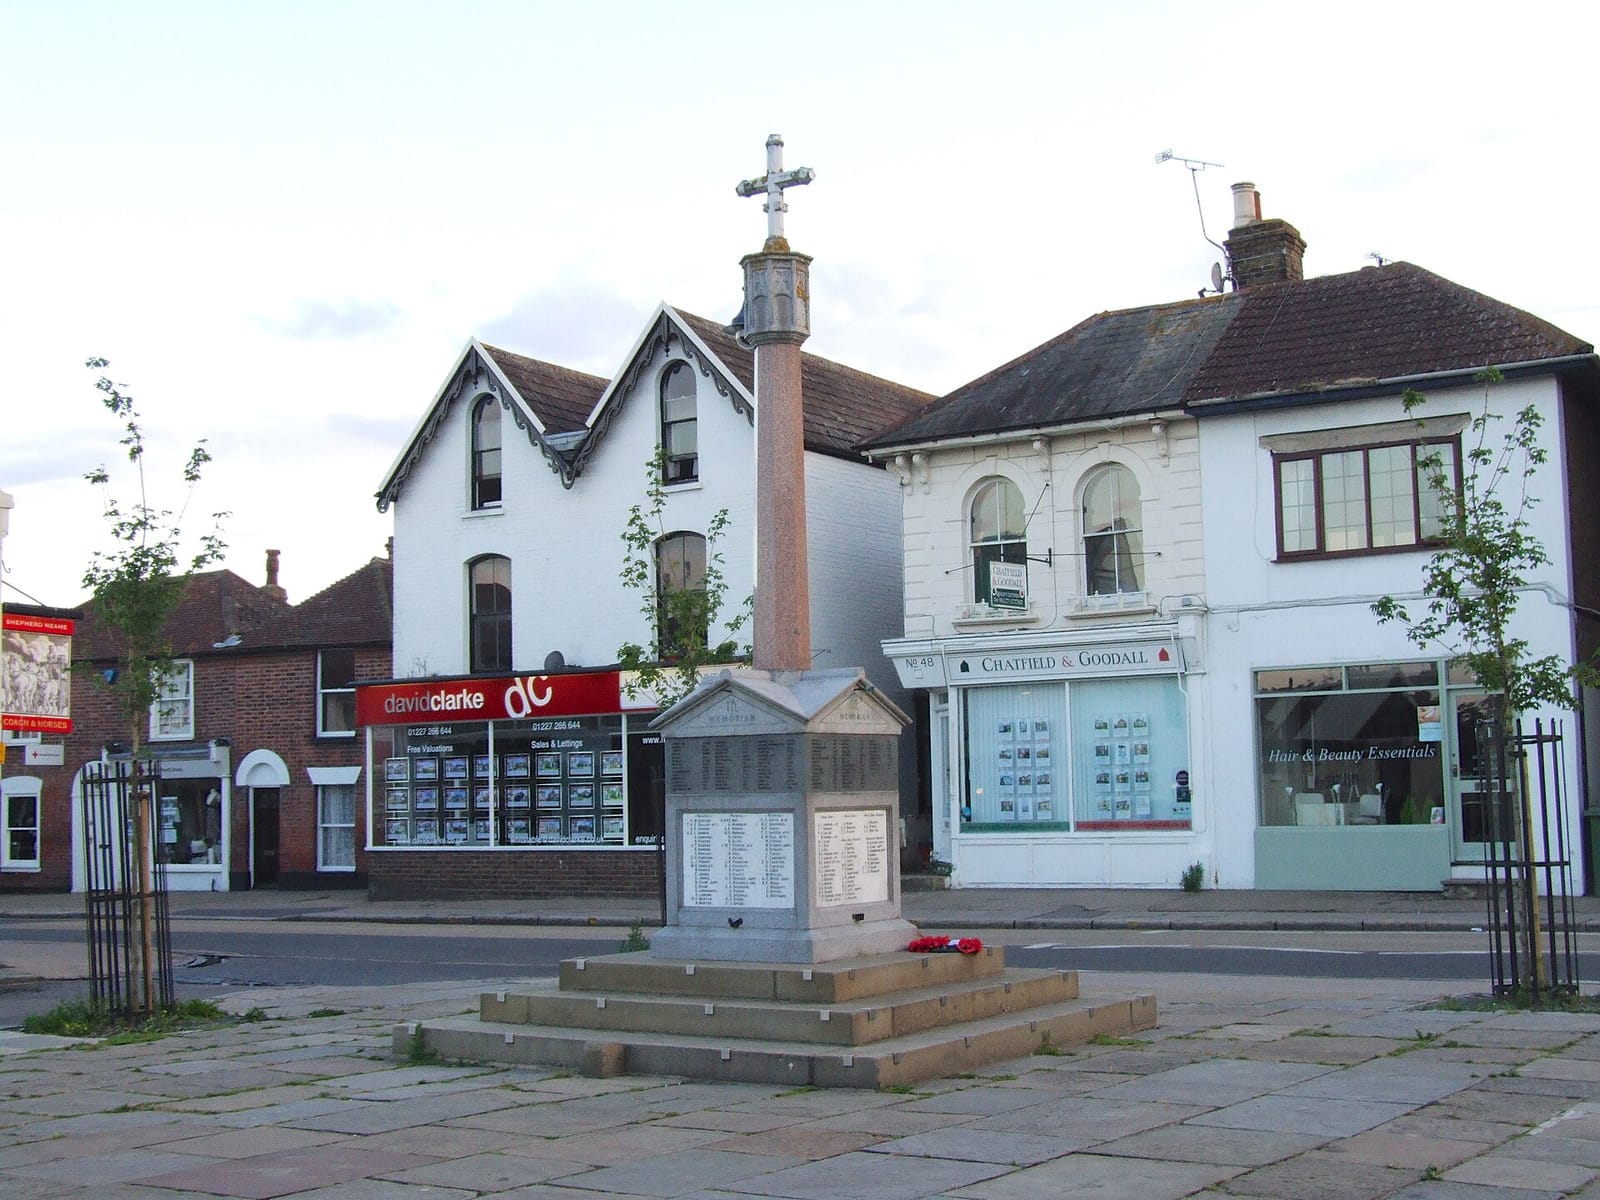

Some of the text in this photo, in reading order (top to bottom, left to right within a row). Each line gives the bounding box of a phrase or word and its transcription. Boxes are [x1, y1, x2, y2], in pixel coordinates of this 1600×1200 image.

[6, 619, 43, 628] SHEPHERD
[920, 657, 934, 668] 48
[982, 651, 1148, 672] CHATFIELD & GOODALL
[384, 688, 485, 713] davidclarke
[3, 718, 29, 727] COACH
[37, 720, 68, 729] HORSES
[532, 722, 552, 731] 01227
[408, 727, 426, 736] 01227
[407, 744, 453, 754] Free Valuations
[531, 739, 583, 749] Sales & Lettings
[1269, 744, 1436, 763] Hair & Beauty Essentials
